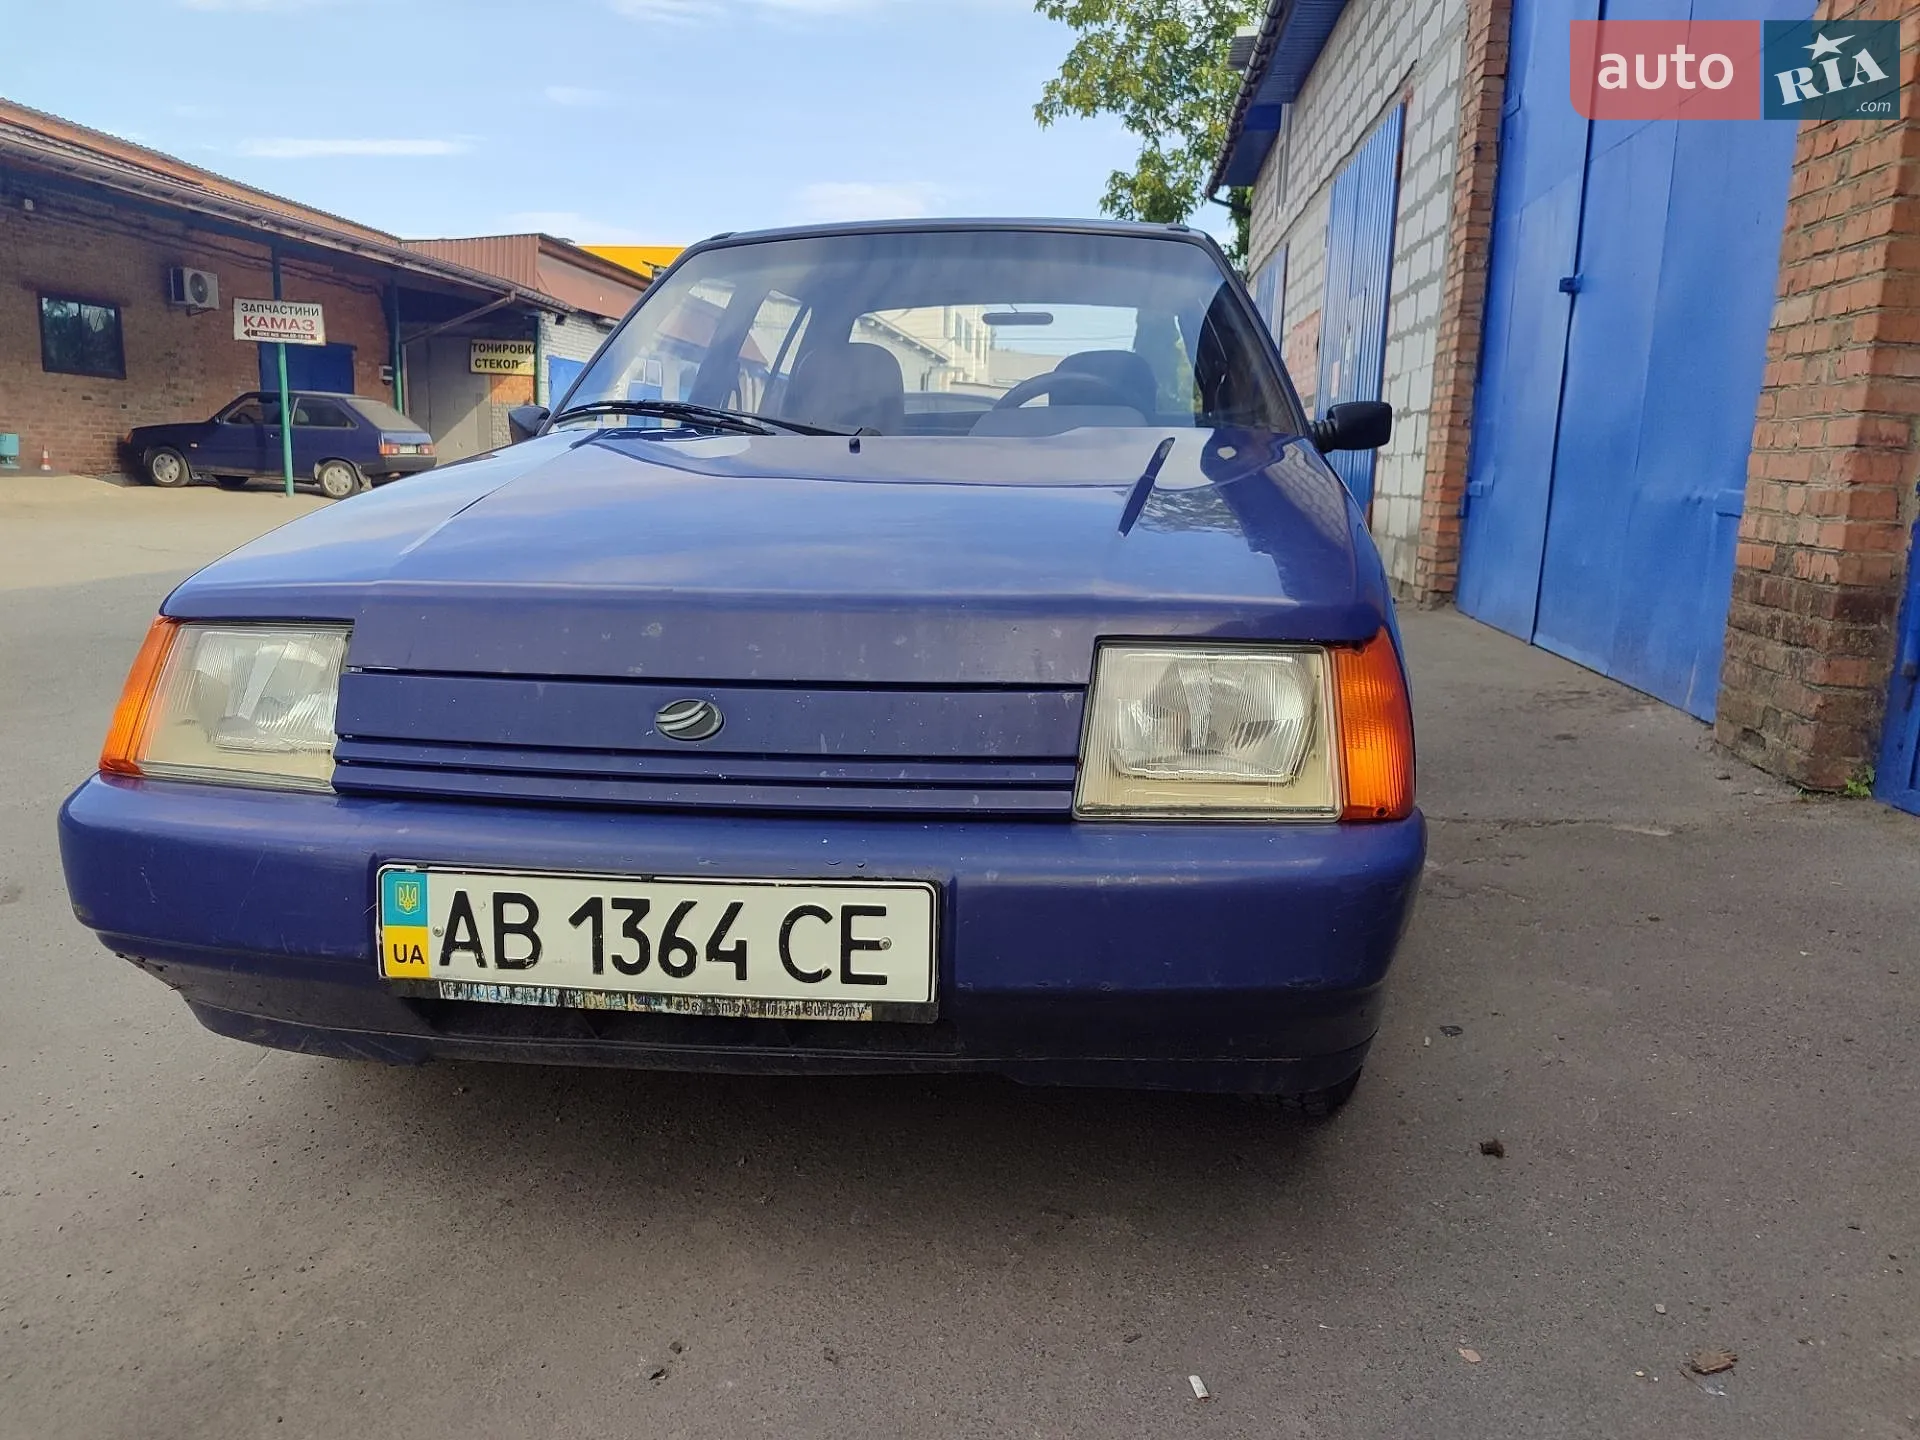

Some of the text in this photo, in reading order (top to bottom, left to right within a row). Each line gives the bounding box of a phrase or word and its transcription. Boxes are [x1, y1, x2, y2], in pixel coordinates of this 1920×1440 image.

[241, 302, 319, 317] ЗАПЧАСТИНИ
[243, 315, 315, 332] КАМАЗ
[474, 358, 519, 369] СТЕКОЛ
[439, 890, 888, 986] AB 1364 CE
[393, 943, 426, 965] UA
